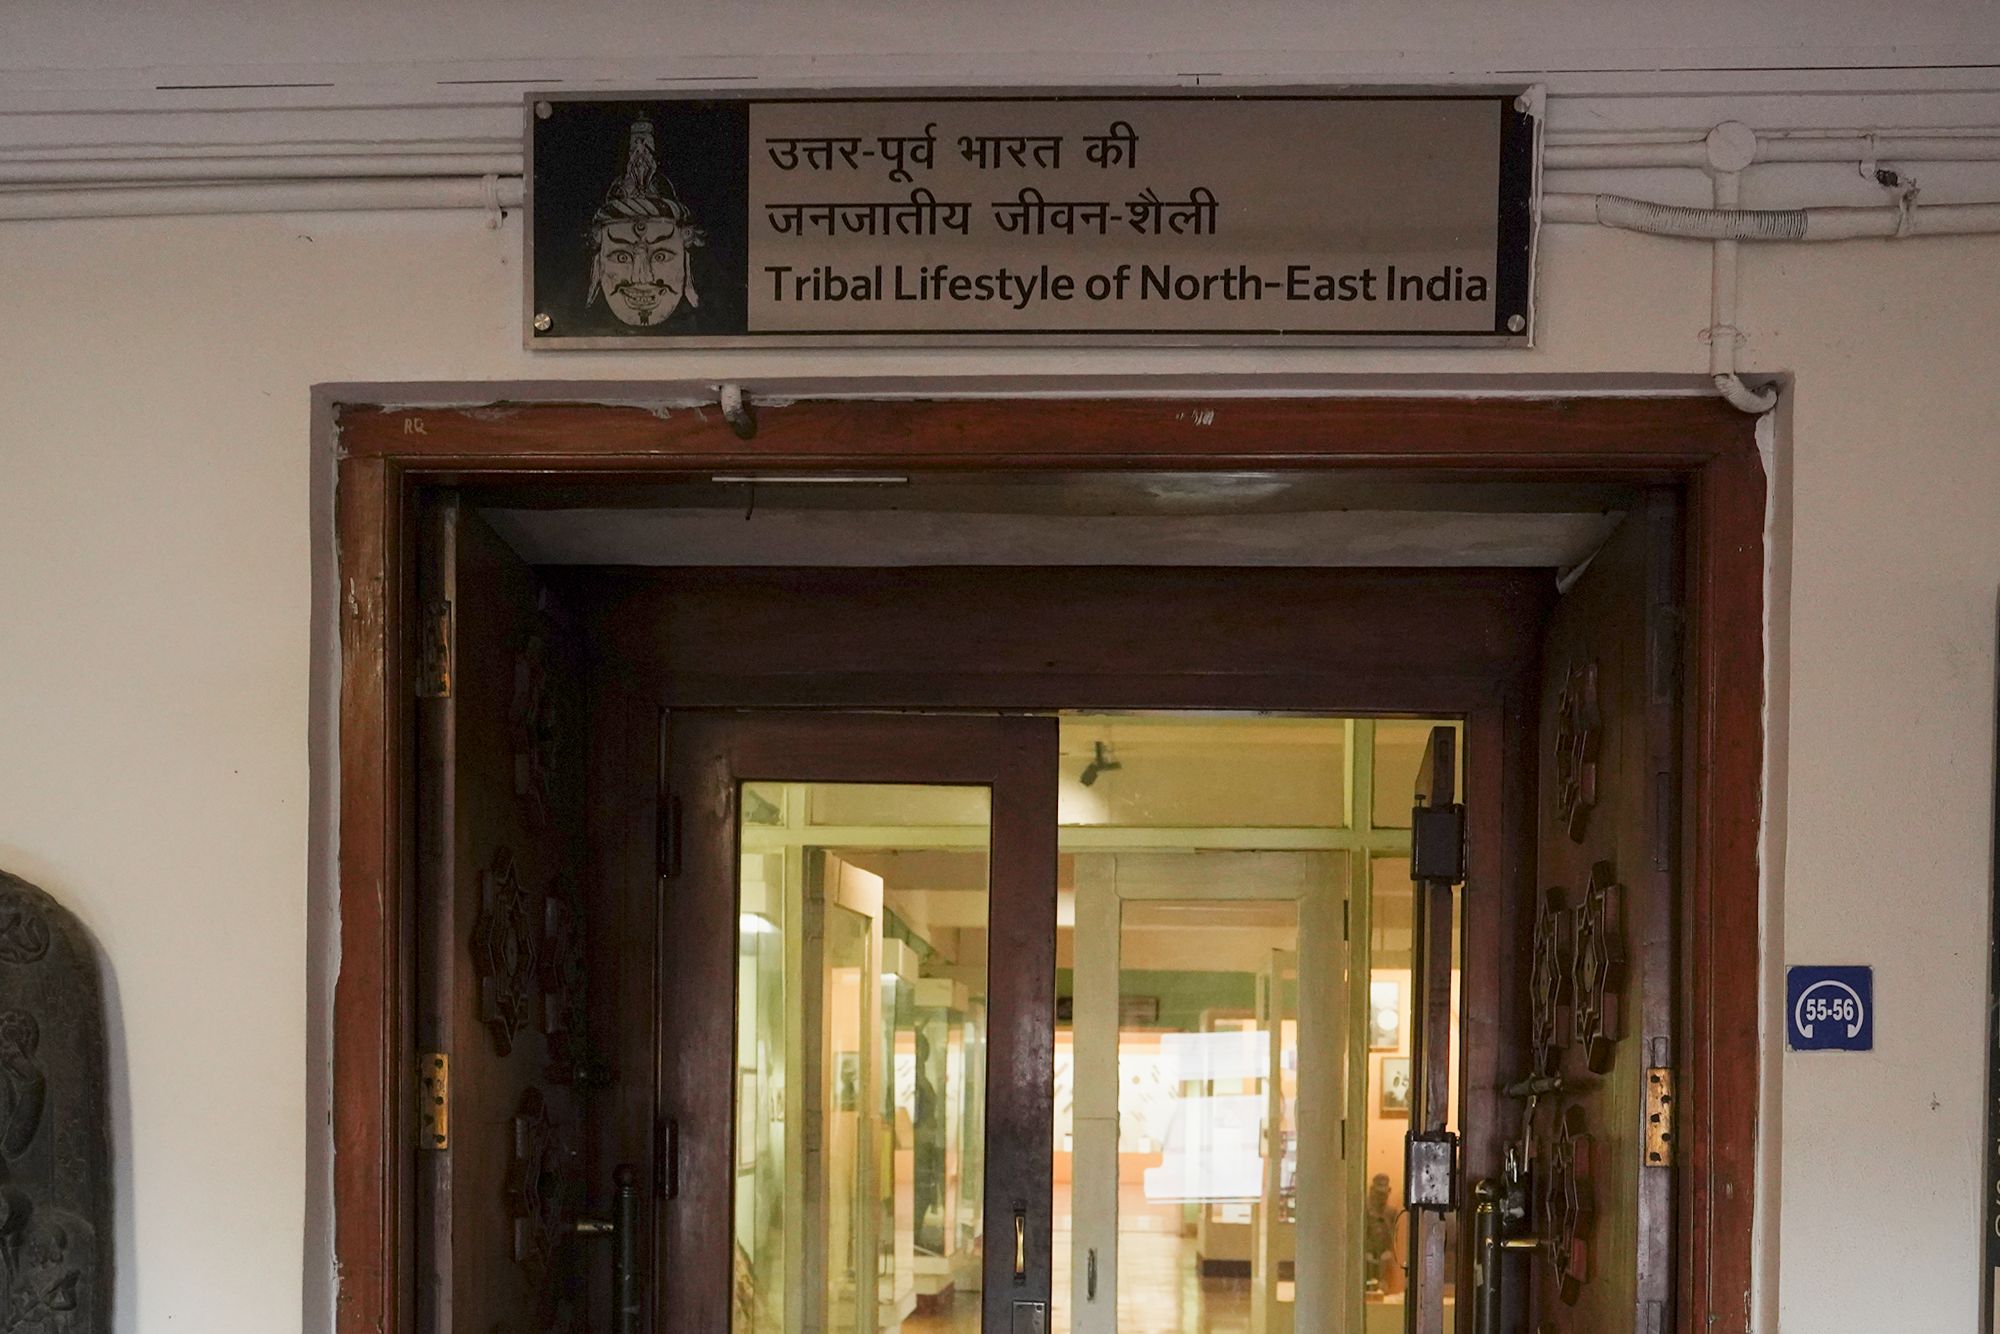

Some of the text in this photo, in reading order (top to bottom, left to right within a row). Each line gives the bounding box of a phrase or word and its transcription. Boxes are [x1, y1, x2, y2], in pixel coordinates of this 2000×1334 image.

[765, 120, 1140, 183] उत्तर-पूर्व भारत की
[764, 186, 1220, 237] जनजातीय जीवन-शैली
[765, 265, 1488, 310] Tribal Lifestyle of North-East India
[1806, 998, 1854, 1021] 55-56
